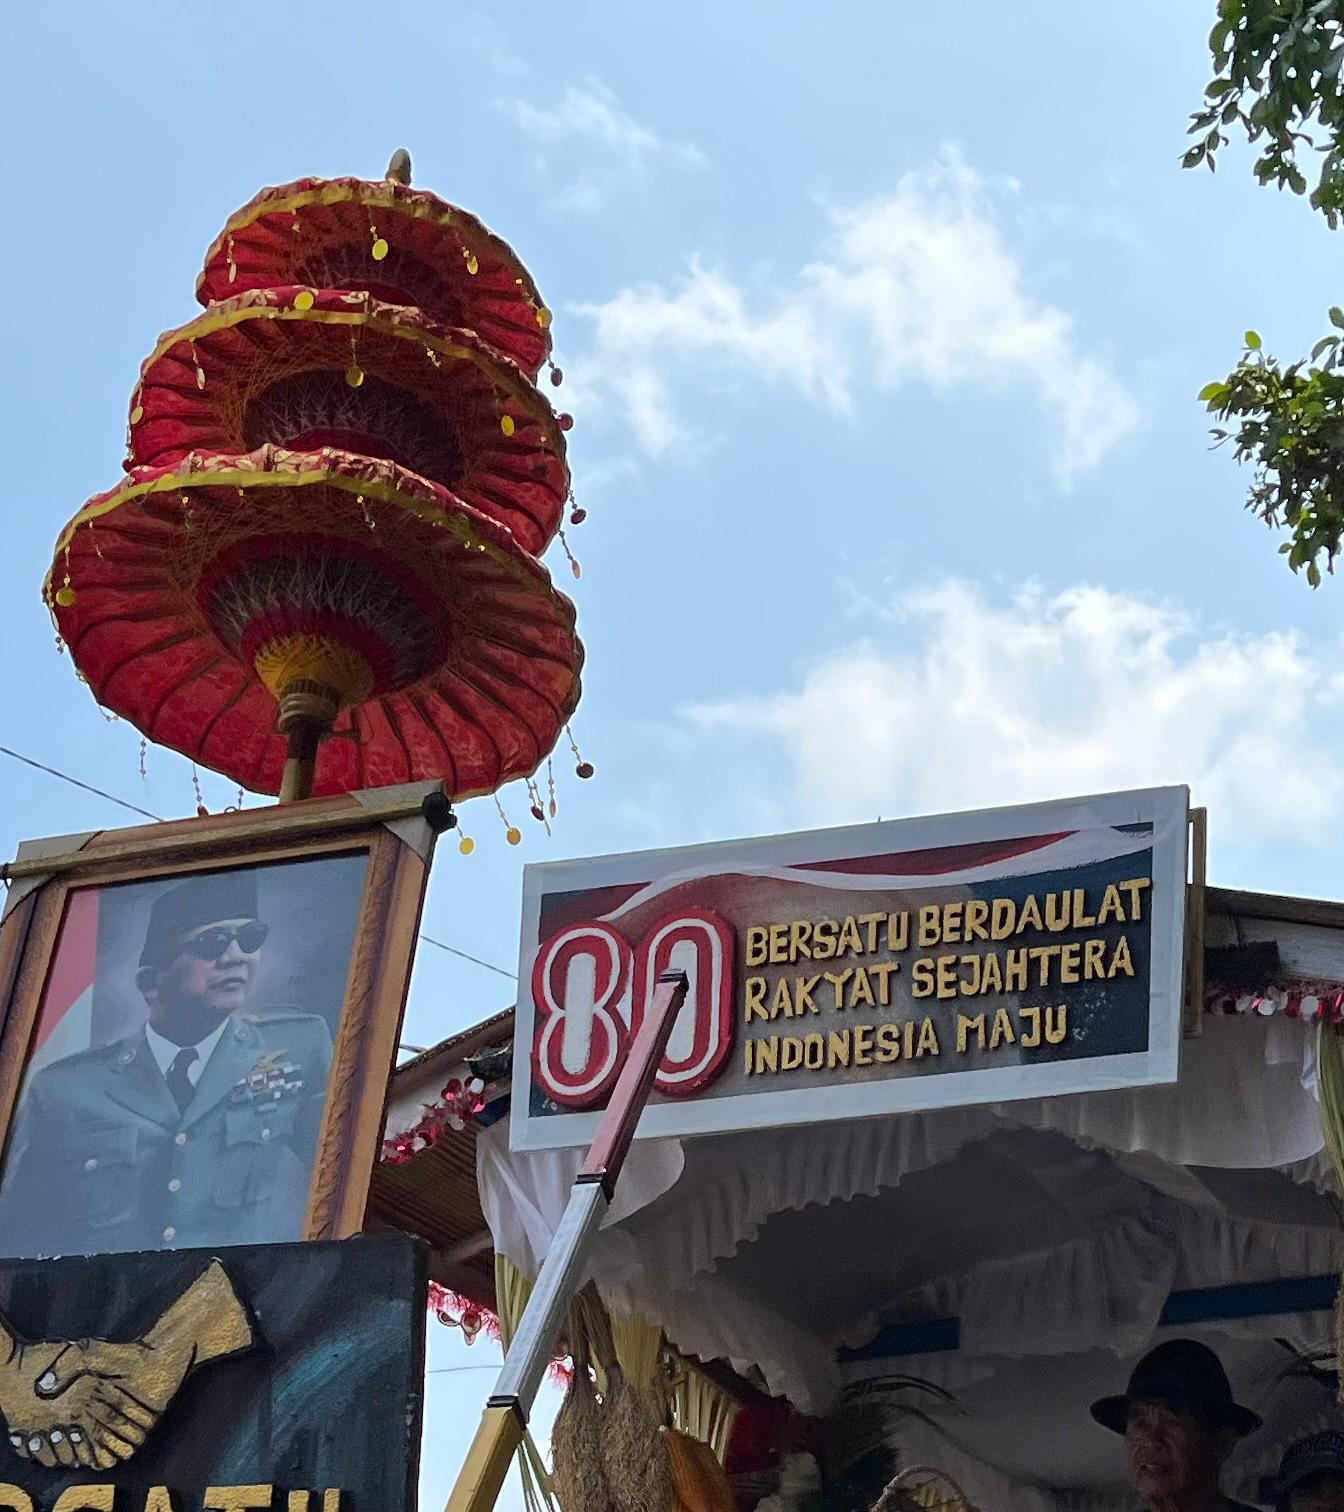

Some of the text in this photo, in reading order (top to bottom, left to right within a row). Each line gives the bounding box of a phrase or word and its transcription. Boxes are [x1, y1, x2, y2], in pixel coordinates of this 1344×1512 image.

[745, 877, 1152, 968] BERSATU BERDAULAT
[531, 904, 736, 1105] 80
[745, 935, 1136, 1024] RAKYAT SEJAHTERA
[744, 1004, 1068, 1076] INDONESIA MAJU
